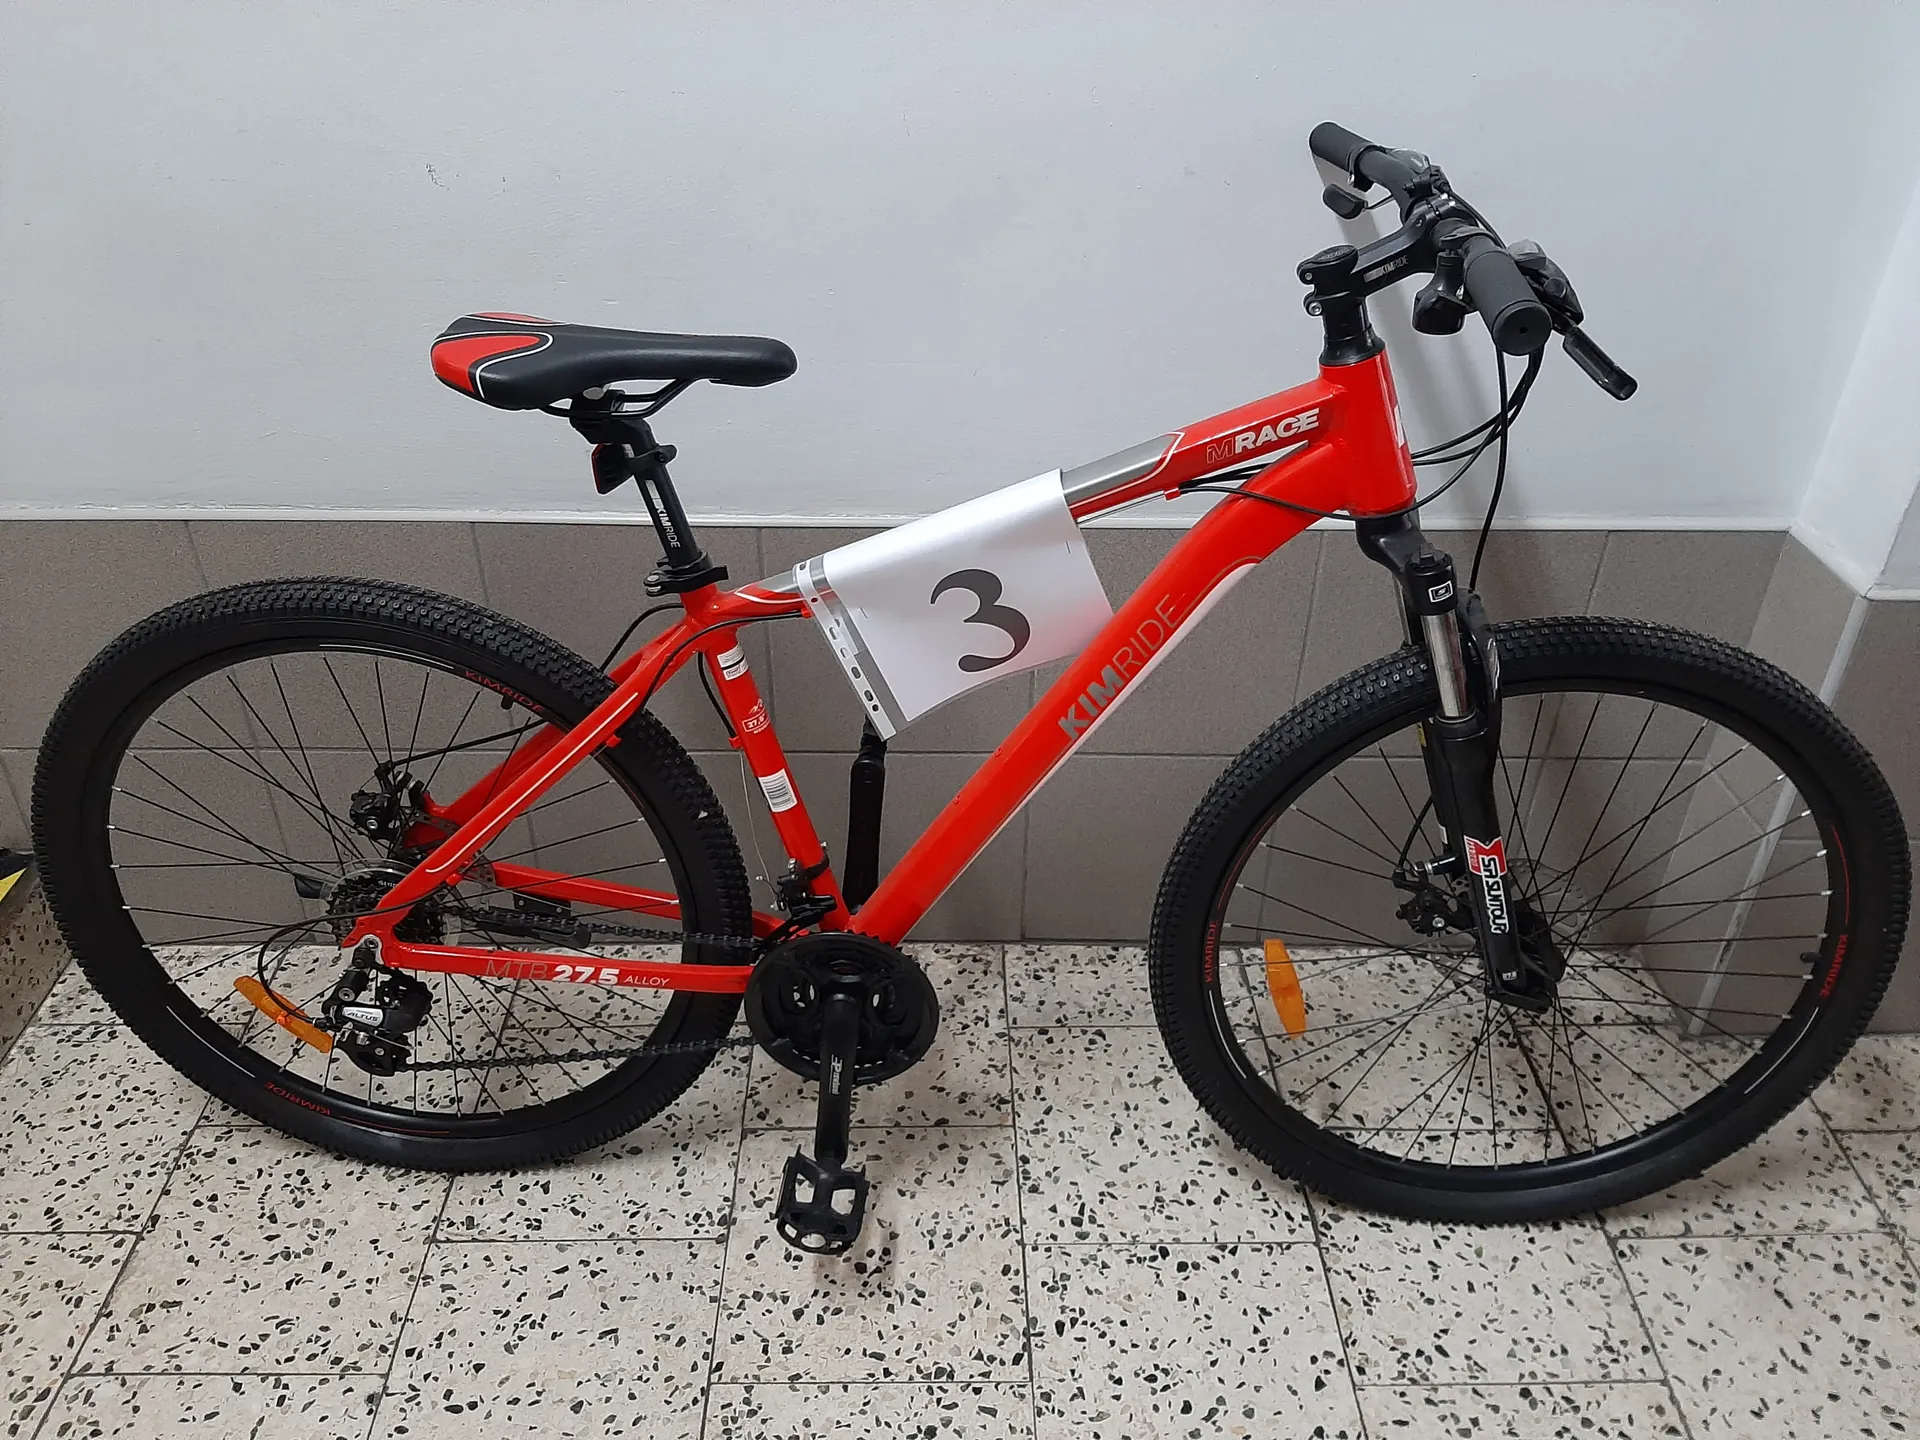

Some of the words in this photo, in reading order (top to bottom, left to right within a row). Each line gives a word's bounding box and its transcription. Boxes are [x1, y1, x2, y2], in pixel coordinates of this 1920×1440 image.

[656, 507, 681, 548] KIMRIDE
[930, 568, 1031, 673] 3
[1057, 593, 1180, 741] KIMRIDE
[465, 670, 545, 712] KIMRIDE
[1485, 878, 1509, 934] SUNTOUR
[485, 959, 548, 980] MTB
[552, 964, 620, 986] 27.5
[623, 974, 670, 987] ALLOY
[346, 1012, 378, 1022] ALTUS
